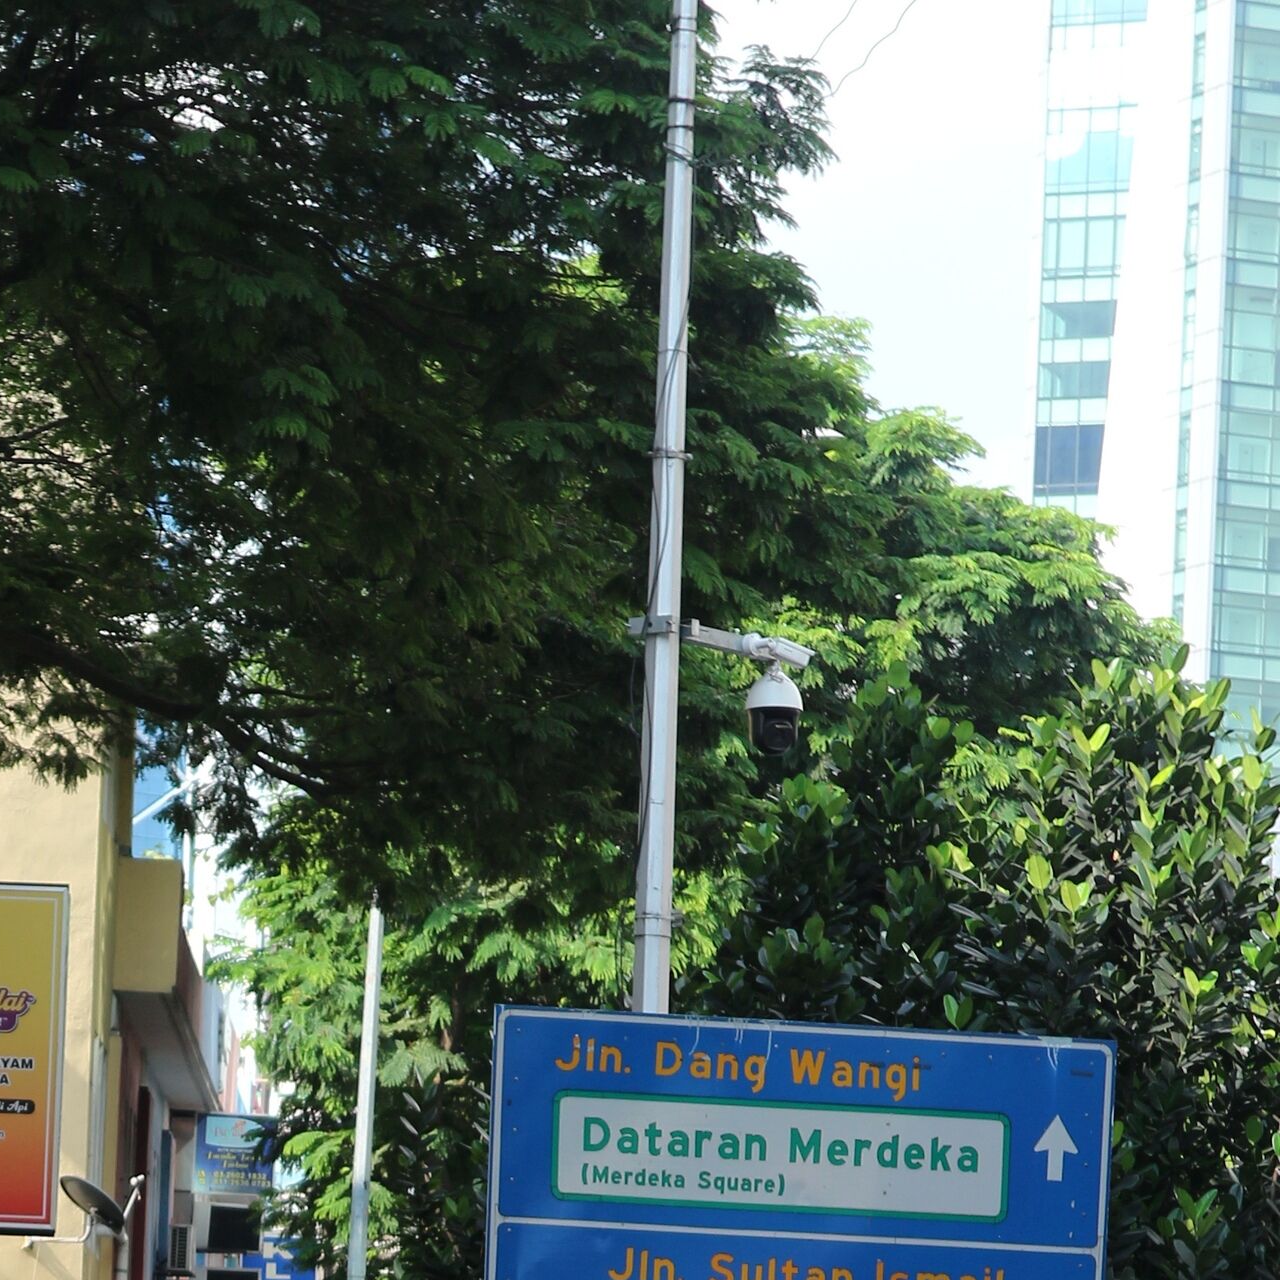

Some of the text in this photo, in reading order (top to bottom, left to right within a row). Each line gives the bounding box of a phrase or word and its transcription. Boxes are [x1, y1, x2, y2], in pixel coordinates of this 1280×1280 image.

[555, 1033, 922, 1102] Jln. Dang Wangi
[6, 1101, 28, 1114] Api
[581, 1116, 981, 1174] Dataran Merdeka
[580, 1162, 786, 1198] (Merdeka Square)
